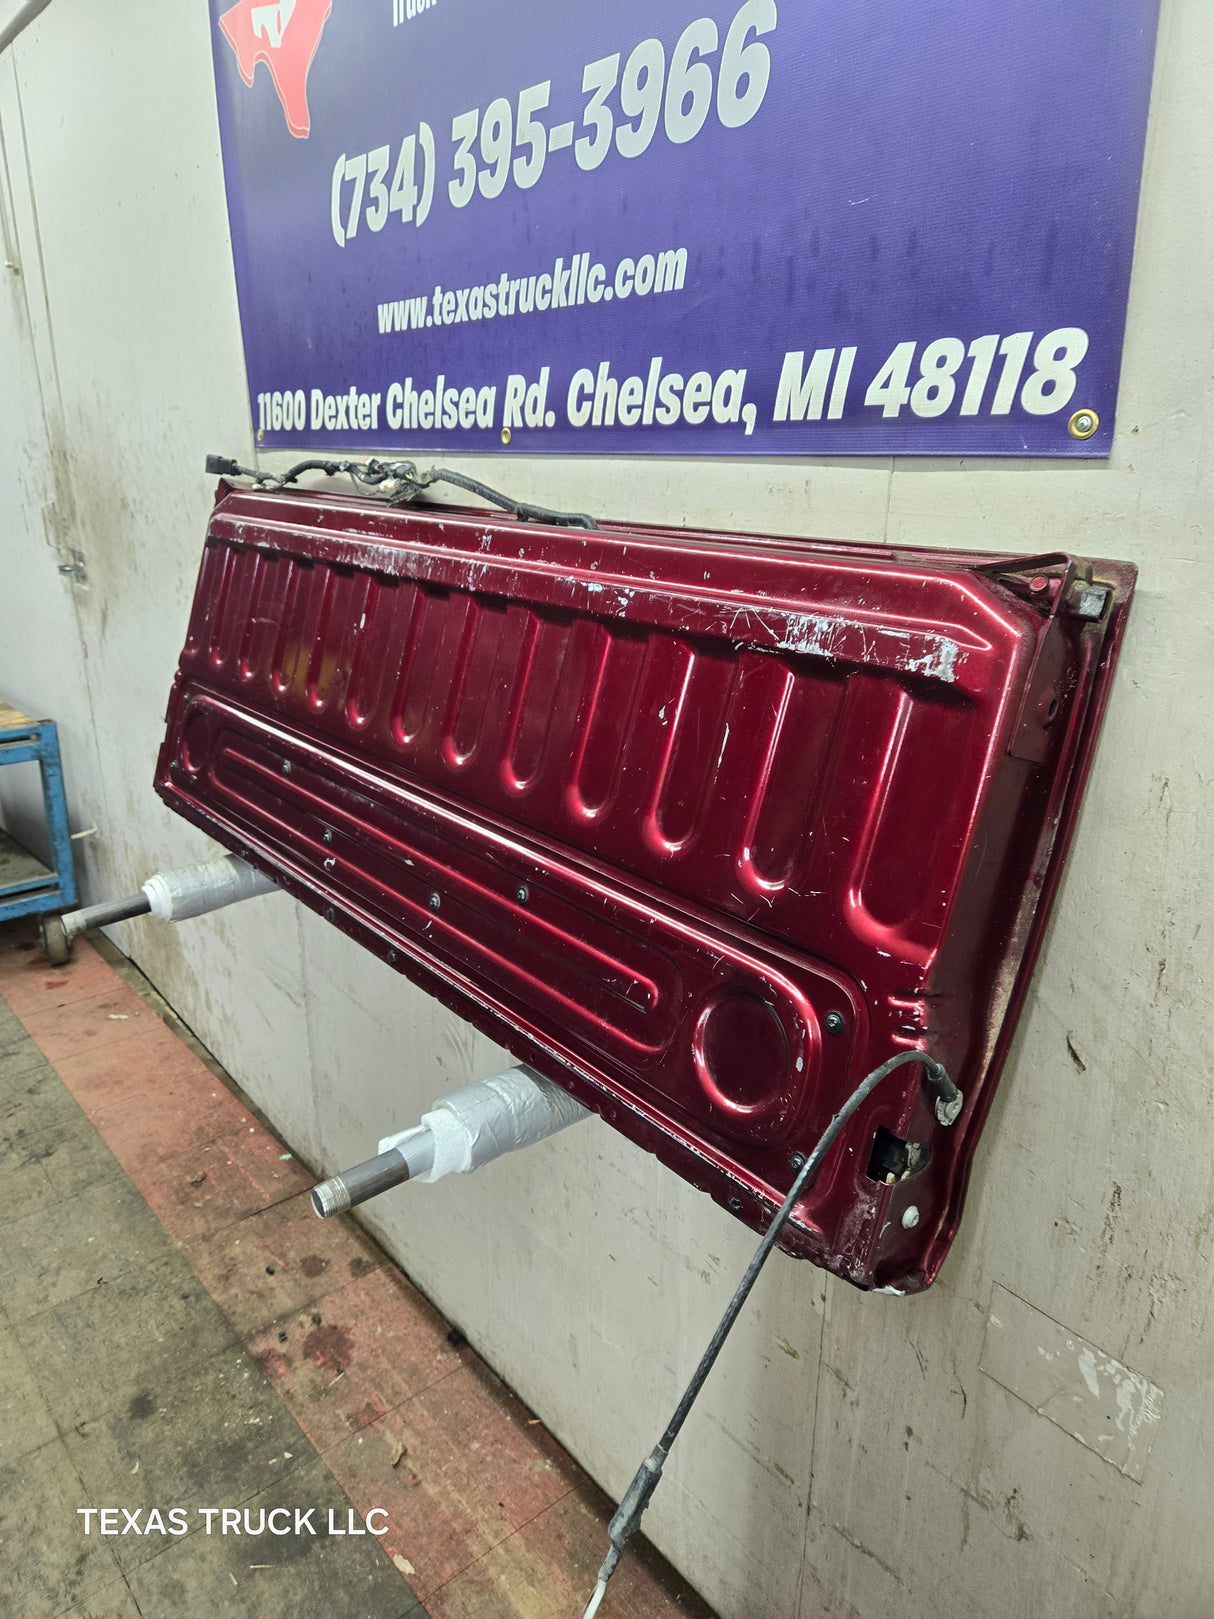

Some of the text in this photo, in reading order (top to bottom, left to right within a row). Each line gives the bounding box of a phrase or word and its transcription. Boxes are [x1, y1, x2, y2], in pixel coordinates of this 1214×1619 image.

[330, 0, 778, 248] (734) 395-3966
[377, 247, 688, 334] www.texastruckllc.com
[257, 327, 1089, 436] 11600 Dexter Chelsea Rd. Chelsea, MI 48118
